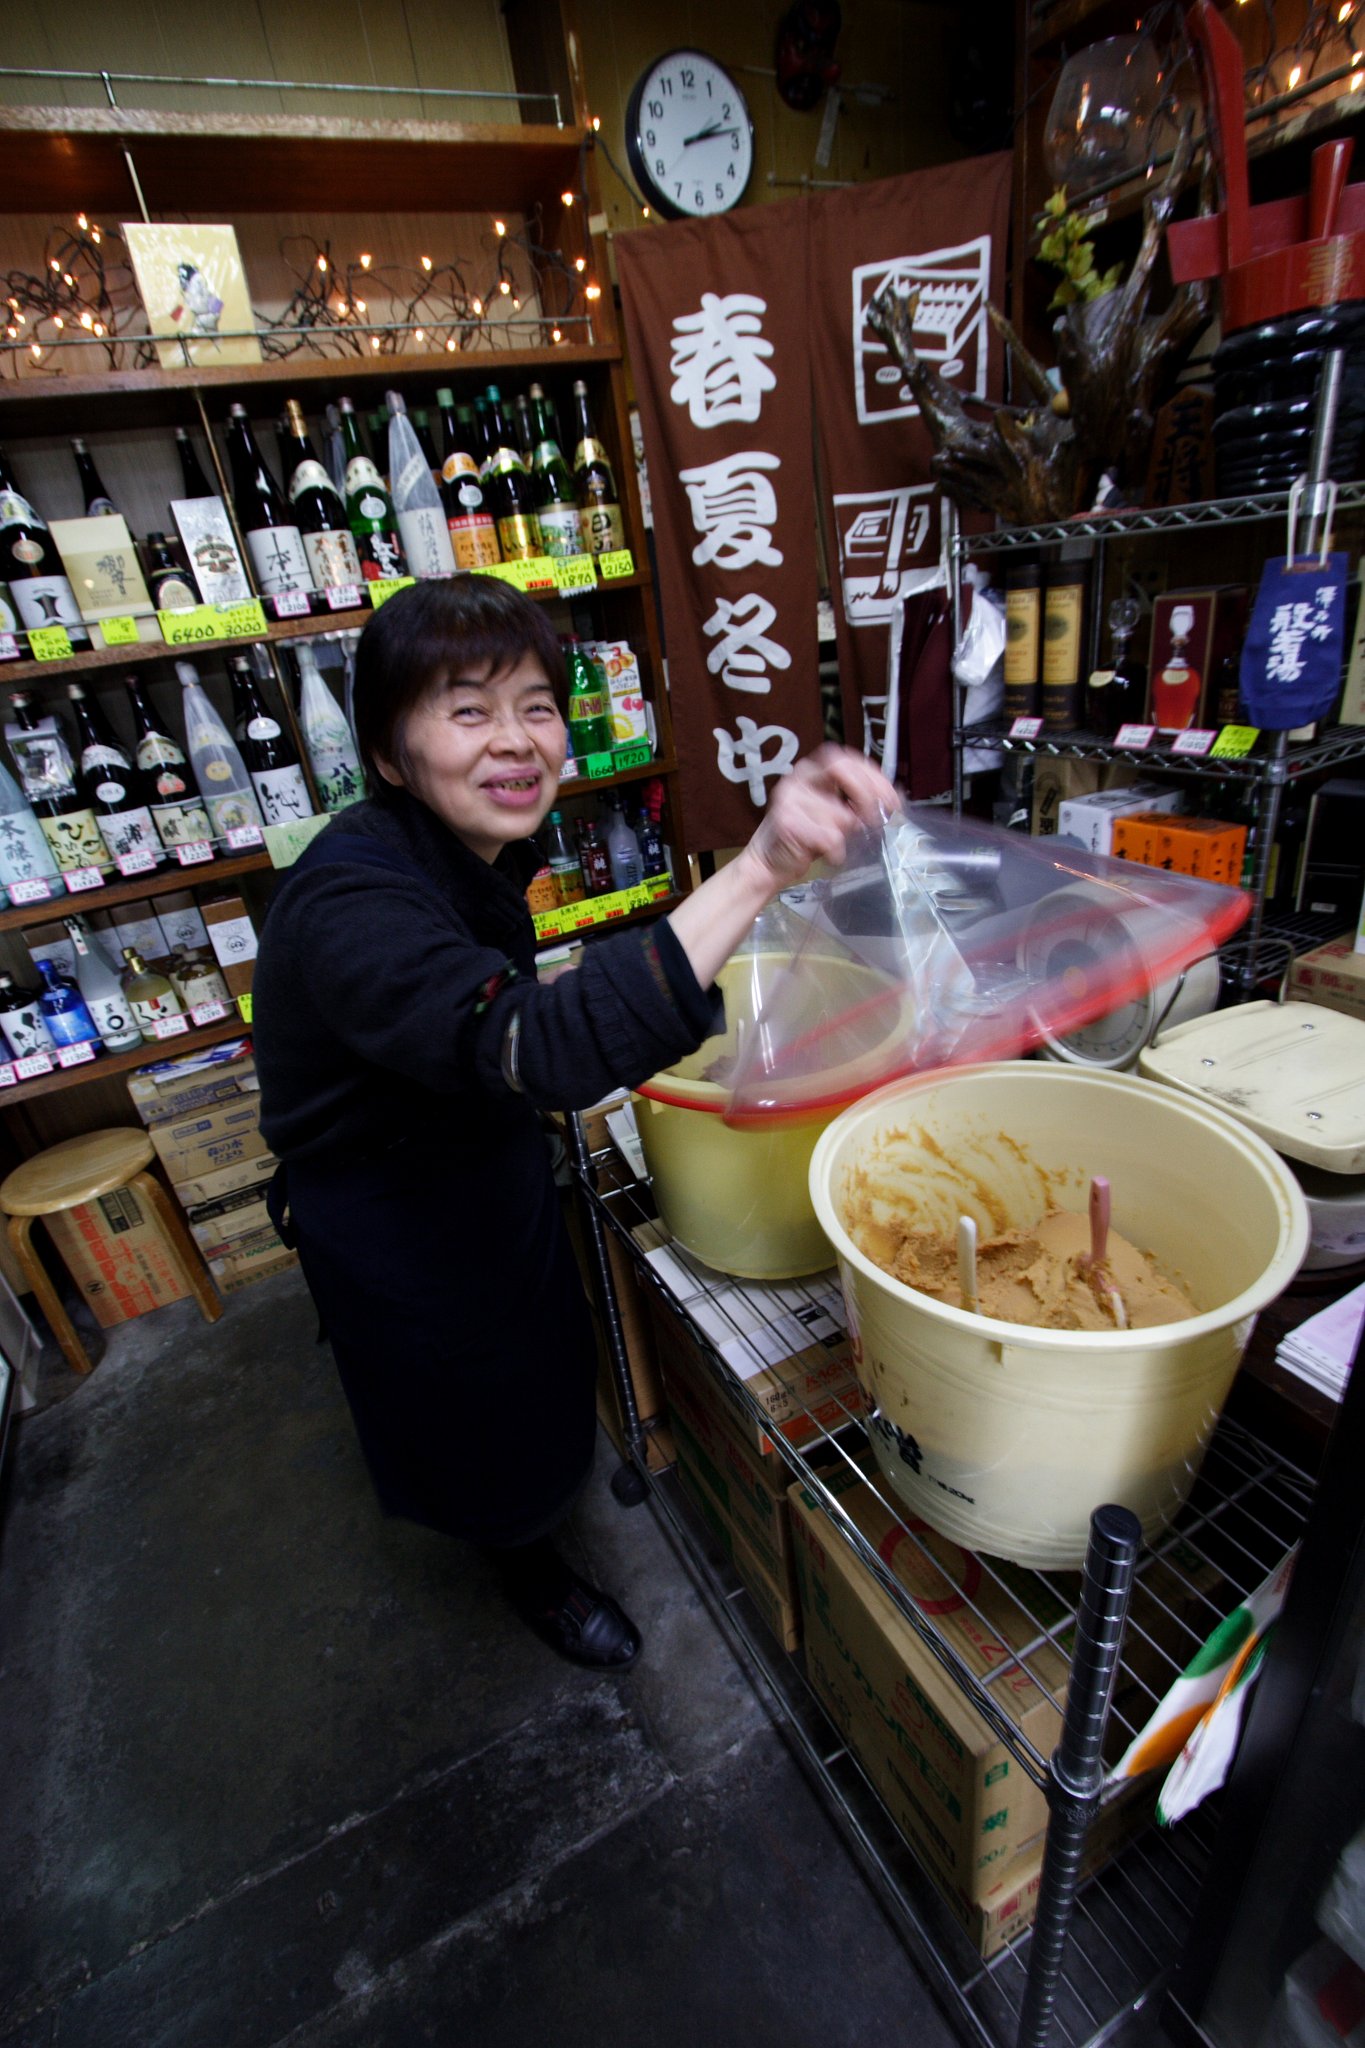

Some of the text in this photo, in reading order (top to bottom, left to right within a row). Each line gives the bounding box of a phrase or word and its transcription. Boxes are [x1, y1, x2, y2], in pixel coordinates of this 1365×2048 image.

[660, 77, 672, 96] 11
[681, 69, 695, 88] 12
[706, 81, 712, 98] 1
[649, 101, 664, 119] 10
[722, 104, 731, 120] 2
[646, 129, 656, 147] 9
[731, 133, 740, 151] 3
[656, 160, 665, 177] 8
[727, 161, 736, 179] 4
[674, 182, 683, 199] 7
[695, 190, 704, 207] 6
[715, 183, 724, 200] 5
[670, 292, 800, 807] 春夏冬中
[172, 625, 215, 643] 6400
[224, 621, 262, 637] 3000
